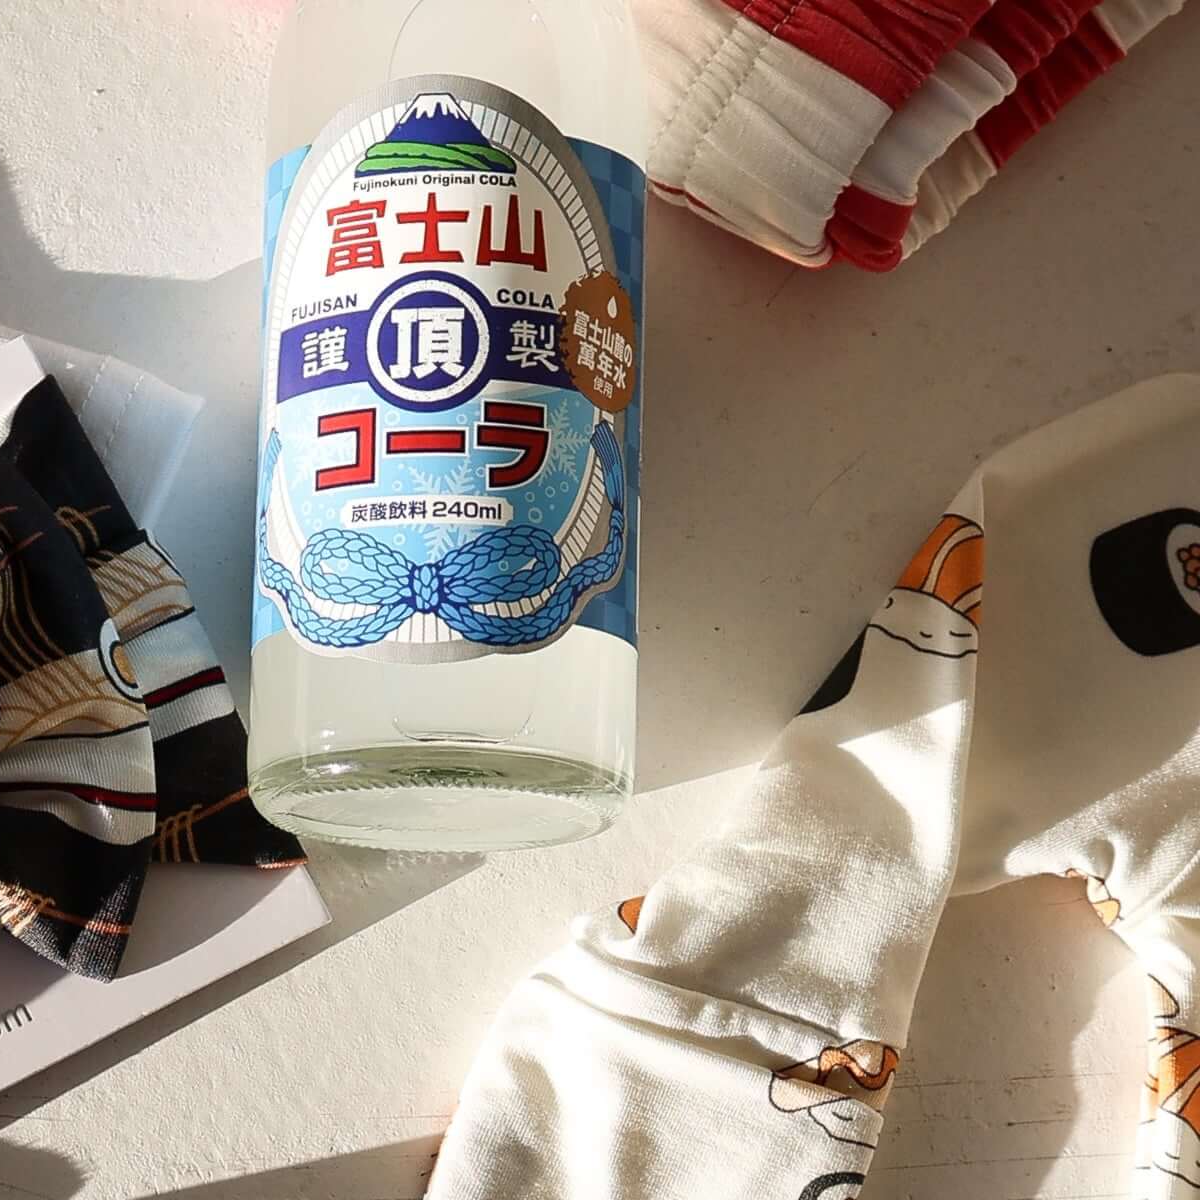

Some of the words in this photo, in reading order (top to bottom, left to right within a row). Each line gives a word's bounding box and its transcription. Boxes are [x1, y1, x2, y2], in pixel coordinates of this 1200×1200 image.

[353, 175, 418, 192] Fujinokuni
[422, 174, 476, 188] Original
[479, 174, 517, 188] COLA
[325, 192, 548, 277] 富士山
[291, 294, 358, 321] FUJISAN
[497, 288, 555, 310] COLA
[302, 327, 349, 378] 謹
[389, 307, 465, 379] 頂
[506, 320, 559, 372] 製
[593, 376, 613, 399] 使用
[315, 401, 550, 492] コーラ
[351, 500, 427, 523] 炭酸飲料
[432, 501, 502, 521] 240ml
